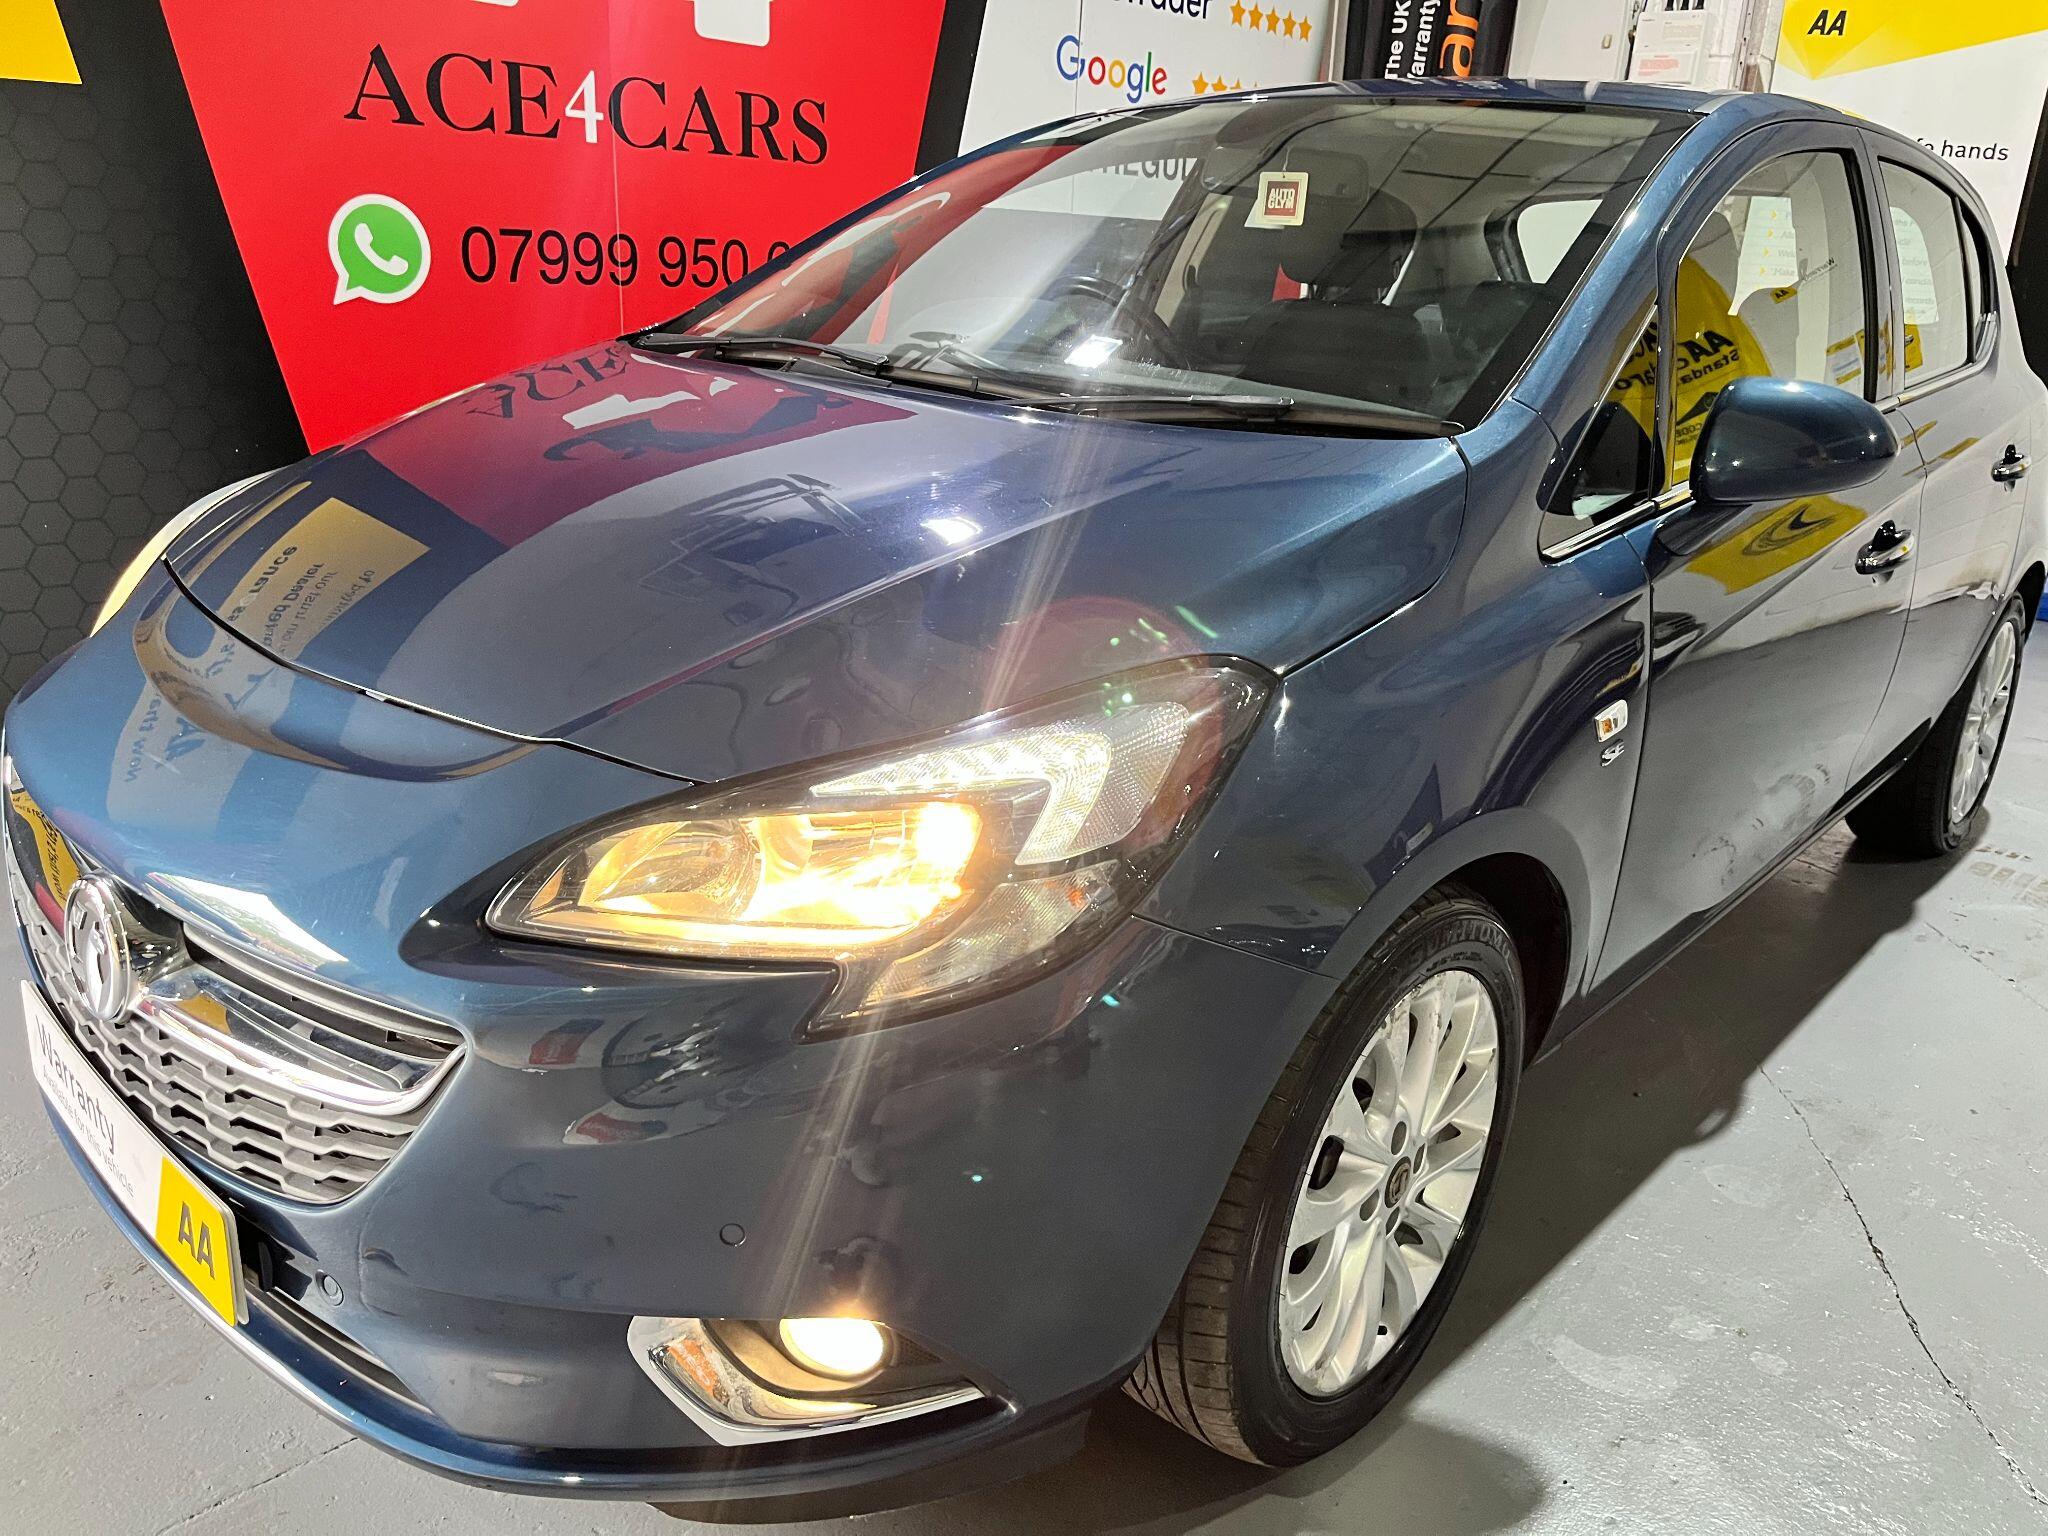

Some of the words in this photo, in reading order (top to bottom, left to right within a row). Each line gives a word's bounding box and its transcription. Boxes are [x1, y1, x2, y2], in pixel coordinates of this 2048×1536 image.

[1807, 9, 1847, 36] AA
[1056, 34, 1167, 103] Google
[1384, 40, 1404, 79] The
[344, 43, 828, 164] ACE4CARS
[1941, 139, 2009, 161] hands
[461, 226, 639, 286] 07999
[659, 236, 749, 288] 950
[35, 1015, 115, 1155] Warranty
[178, 1200, 216, 1281] AA
